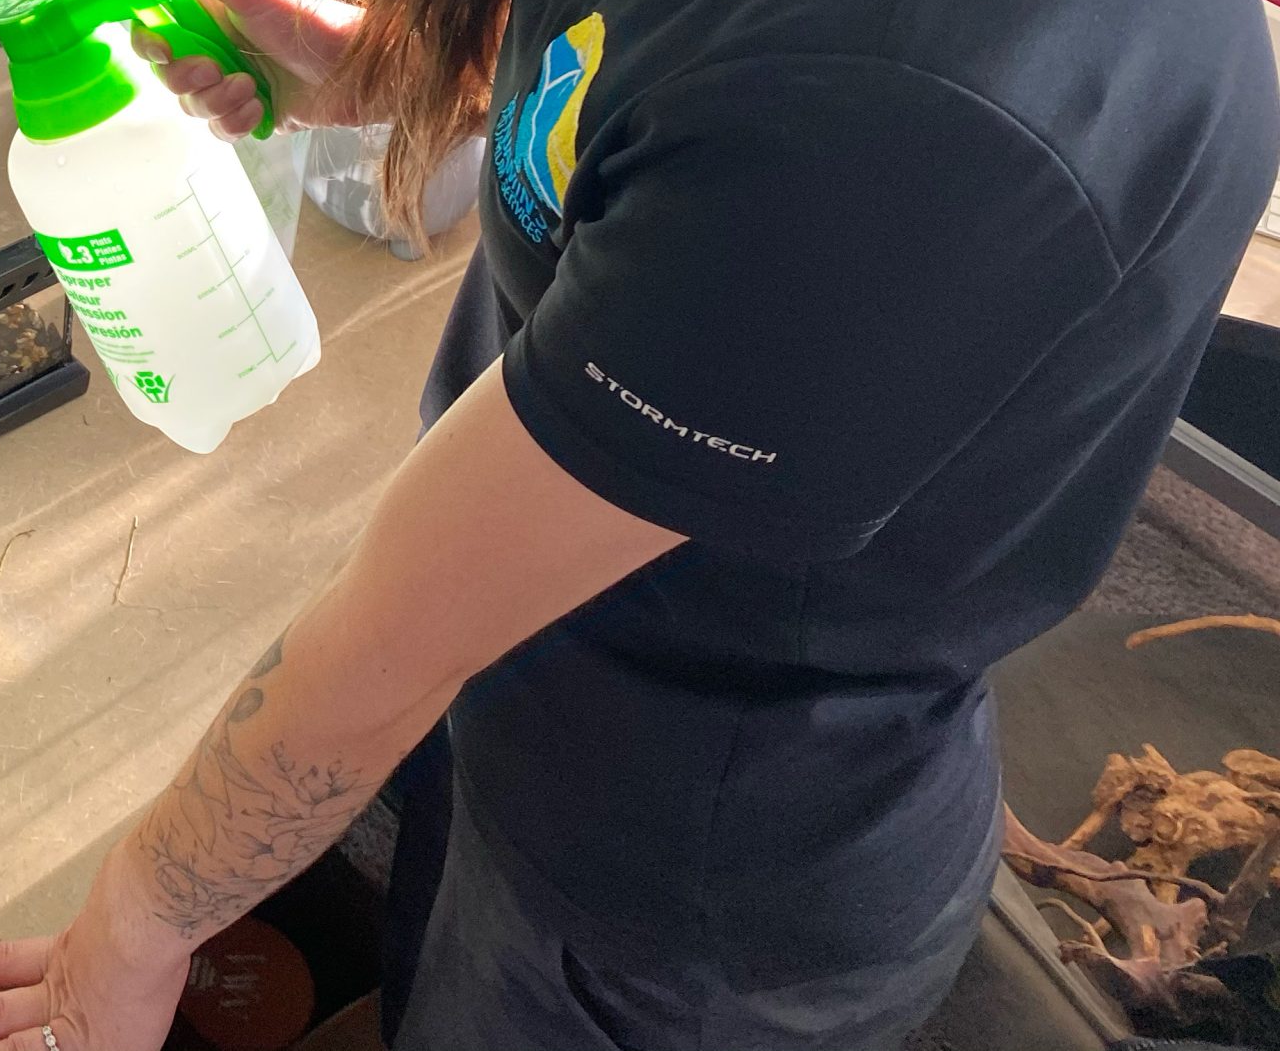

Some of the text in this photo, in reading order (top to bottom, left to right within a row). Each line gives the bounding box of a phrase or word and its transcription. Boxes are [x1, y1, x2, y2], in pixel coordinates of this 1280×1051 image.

[502, 182, 543, 243] SERVICES
[57, 240, 95, 264] 2.3
[89, 236, 114, 248] Pints
[584, 361, 778, 464] STORMTECH
